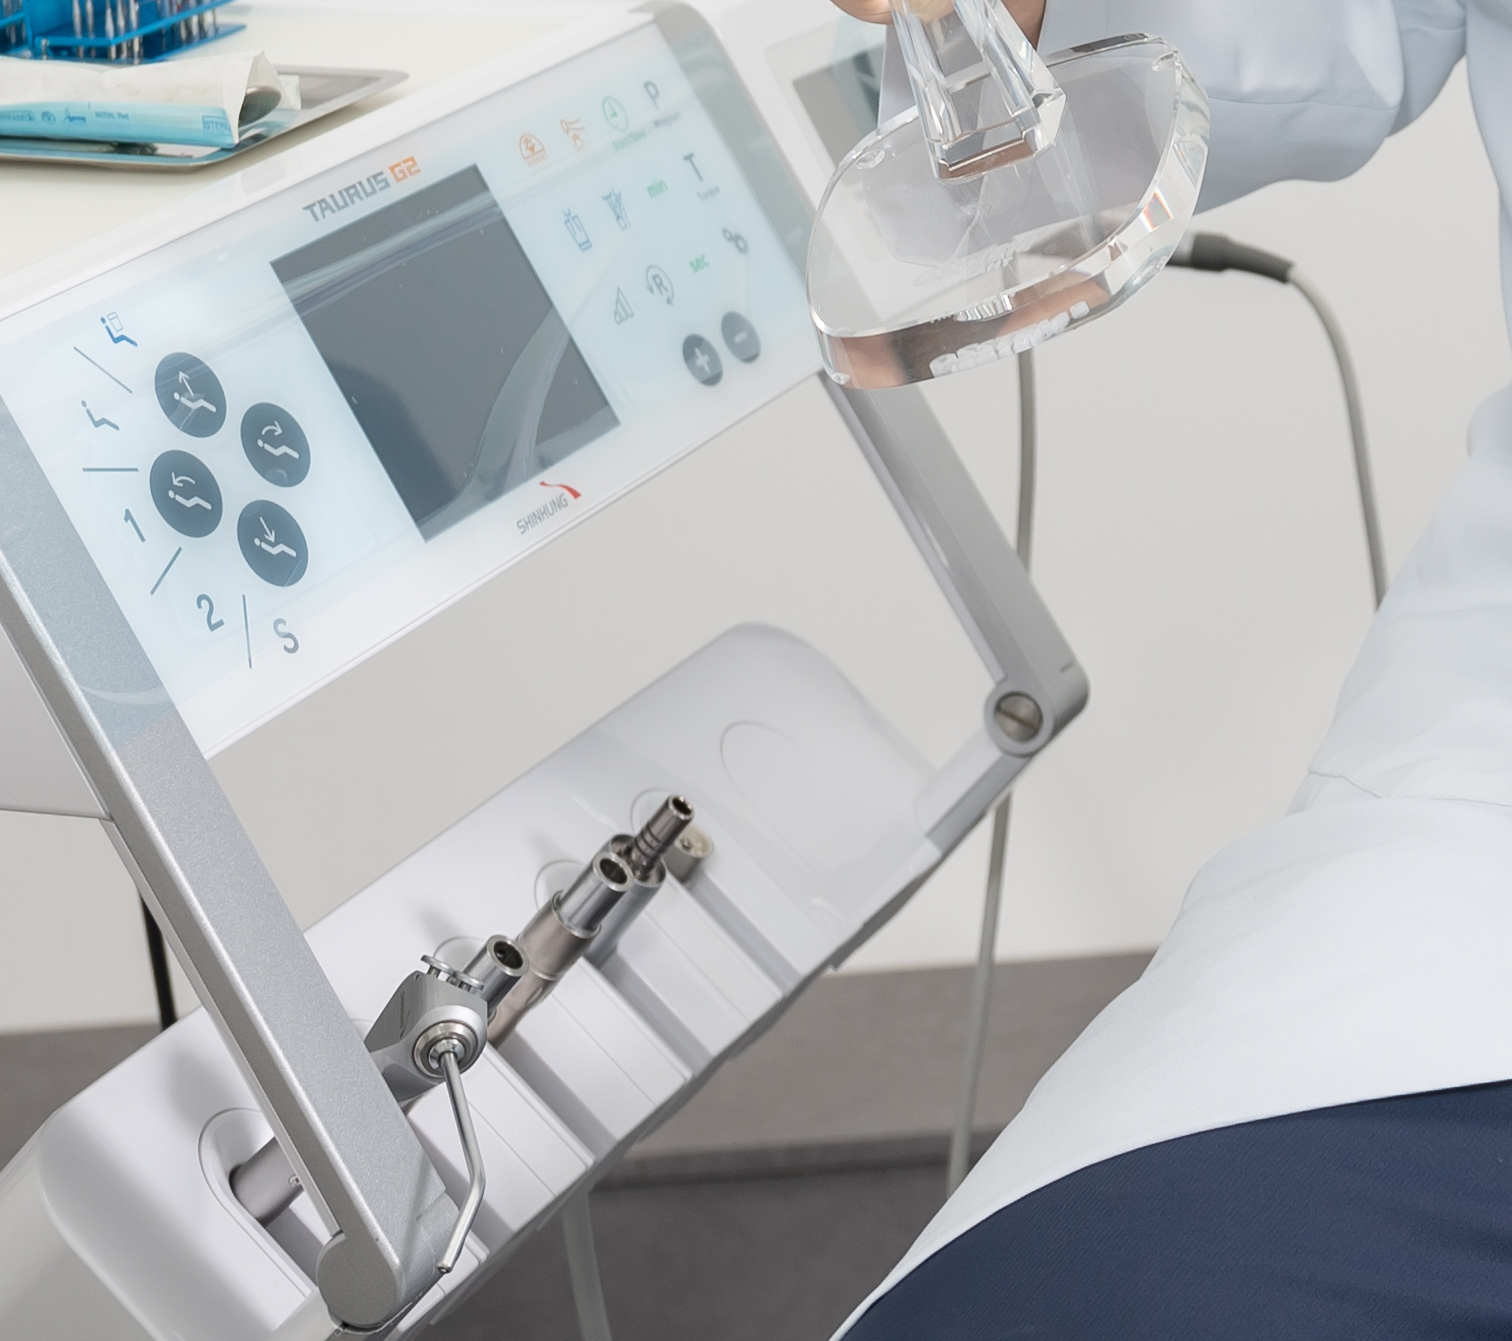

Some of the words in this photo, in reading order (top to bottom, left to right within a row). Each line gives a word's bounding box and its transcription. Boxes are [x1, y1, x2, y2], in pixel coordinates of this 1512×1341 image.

[643, 79, 660, 110] P
[682, 152, 704, 182] T
[302, 170, 392, 223] TAURUS
[387, 155, 422, 184] G2
[646, 179, 669, 199] min
[689, 254, 710, 273] sec
[123, 508, 146, 543] 1
[516, 492, 569, 536] SHINHUNG
[196, 593, 225, 633] 2
[273, 617, 300, 654] S
